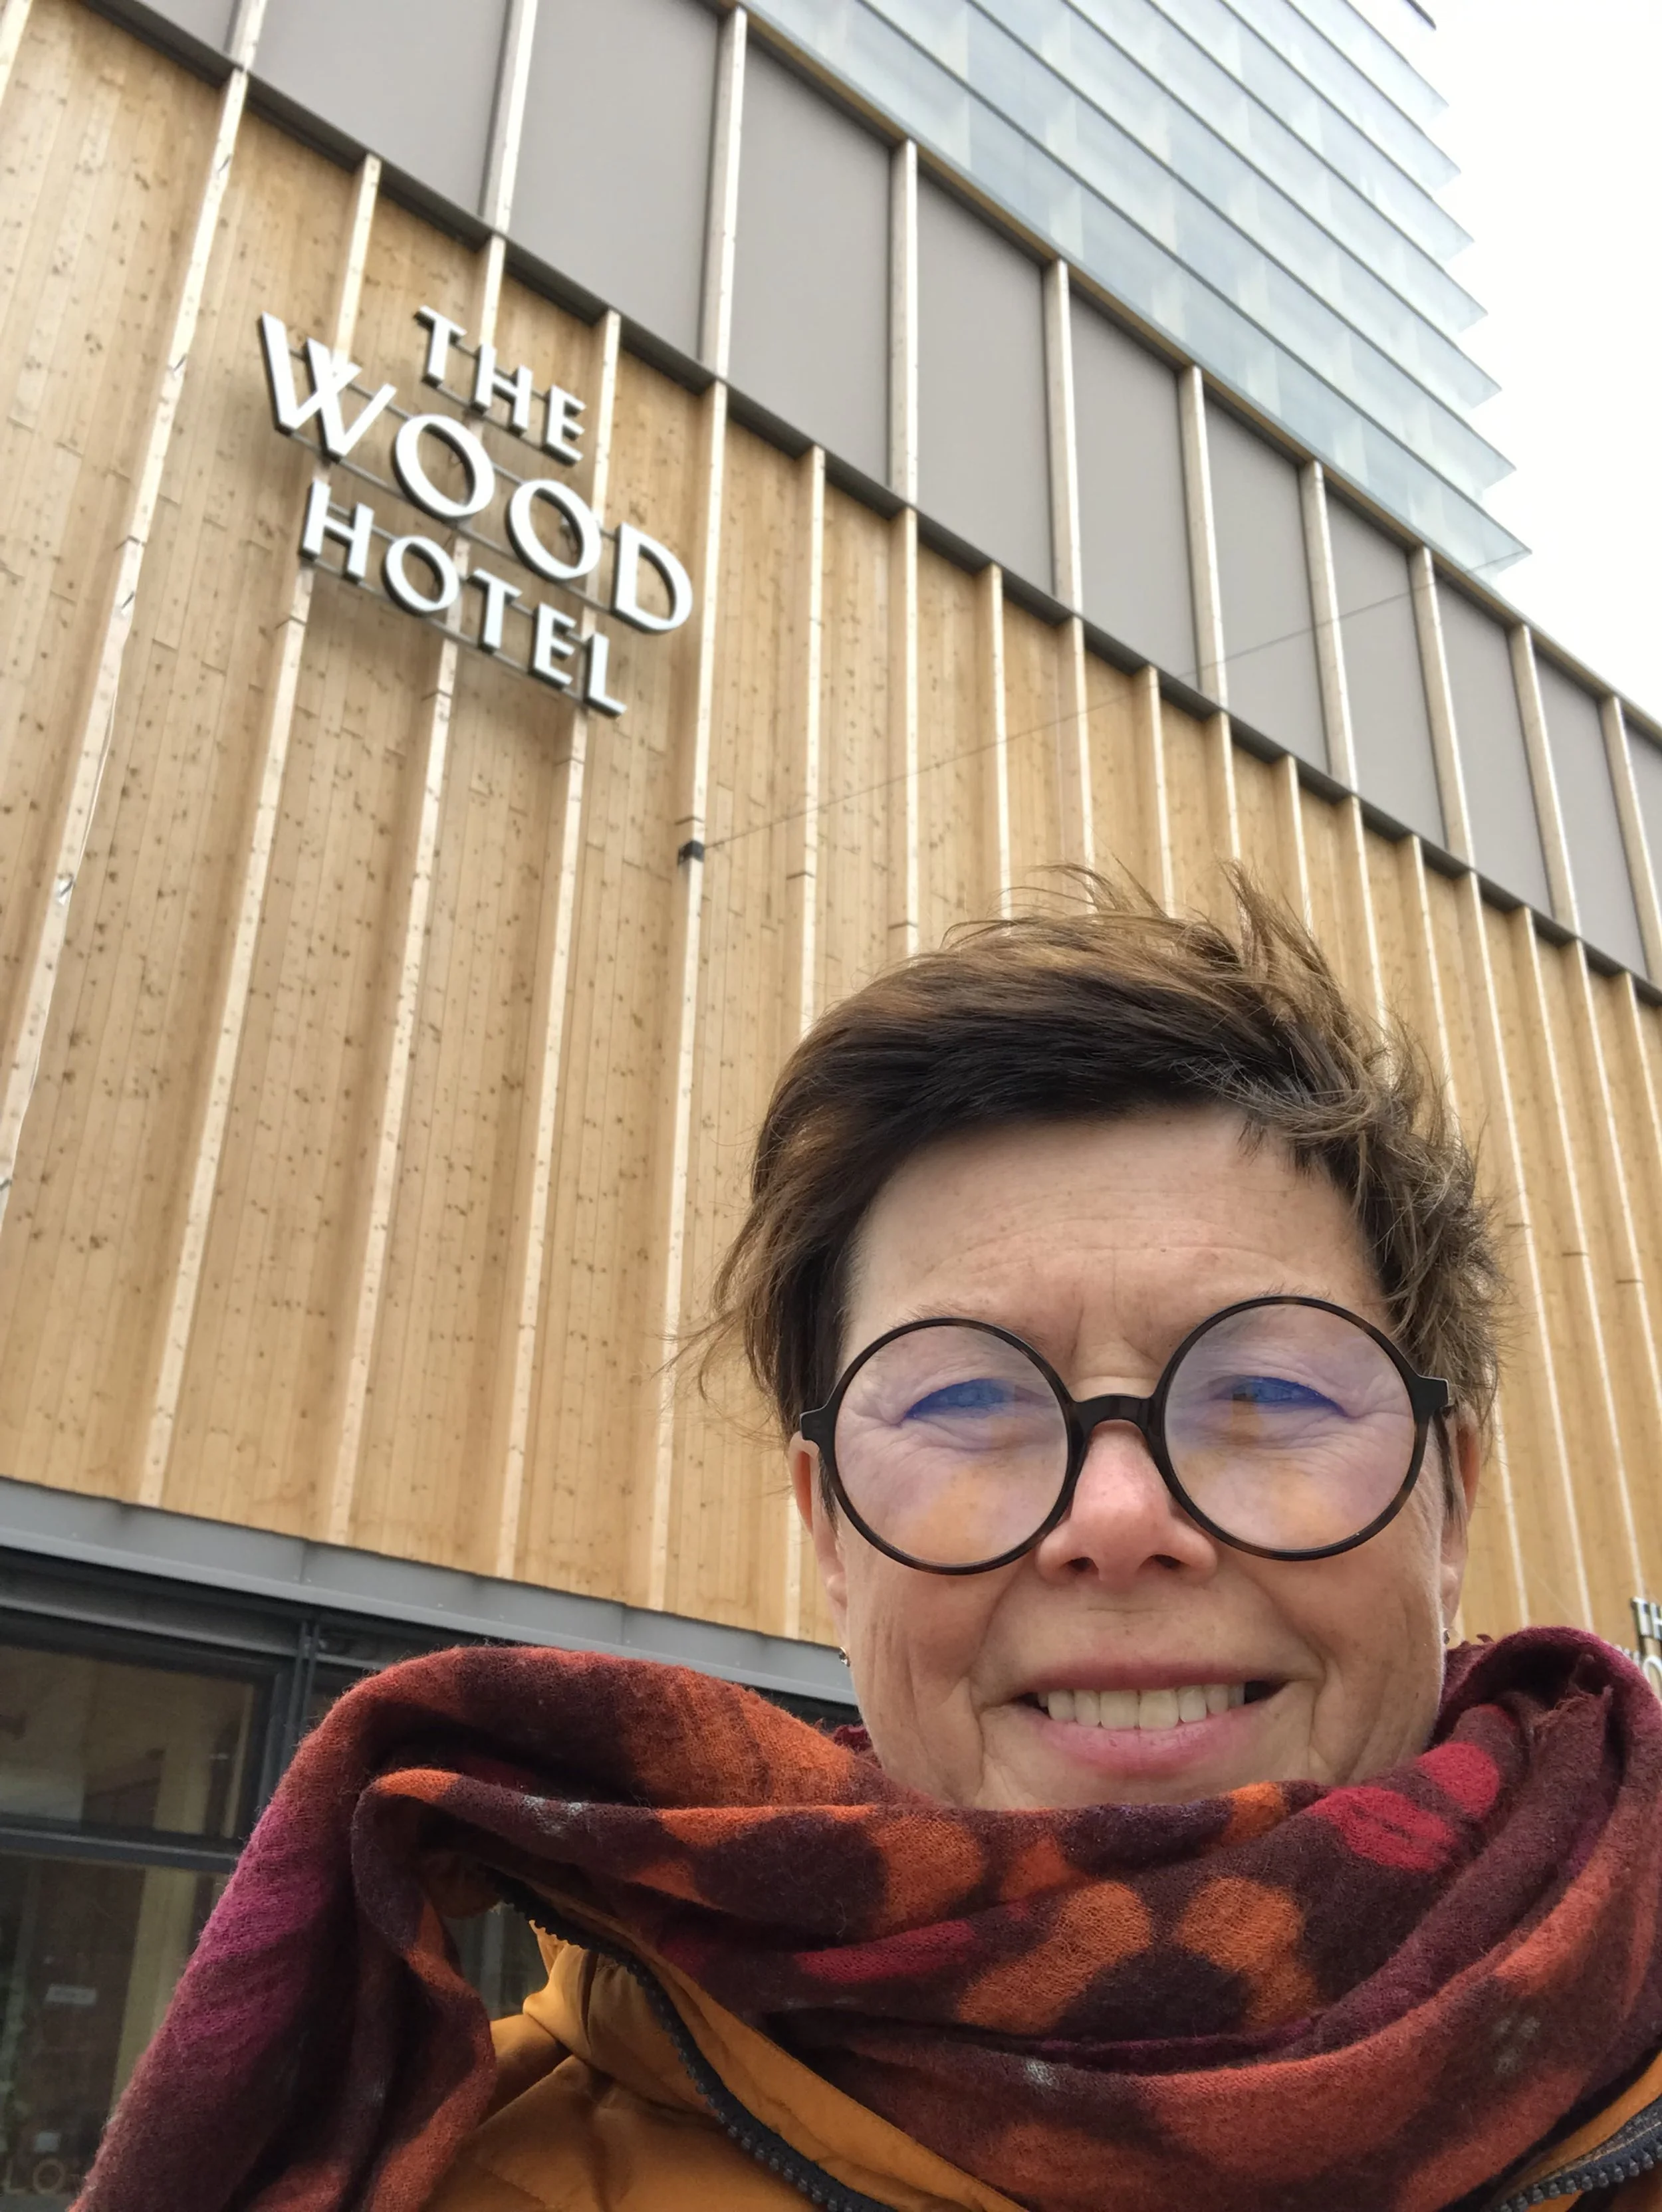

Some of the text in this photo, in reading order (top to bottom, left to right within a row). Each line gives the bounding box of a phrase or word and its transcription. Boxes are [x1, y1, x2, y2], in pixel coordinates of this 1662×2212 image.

[261, 312, 693, 634] WOOD
[414, 305, 586, 466] THE
[300, 480, 627, 717] HOTEL
